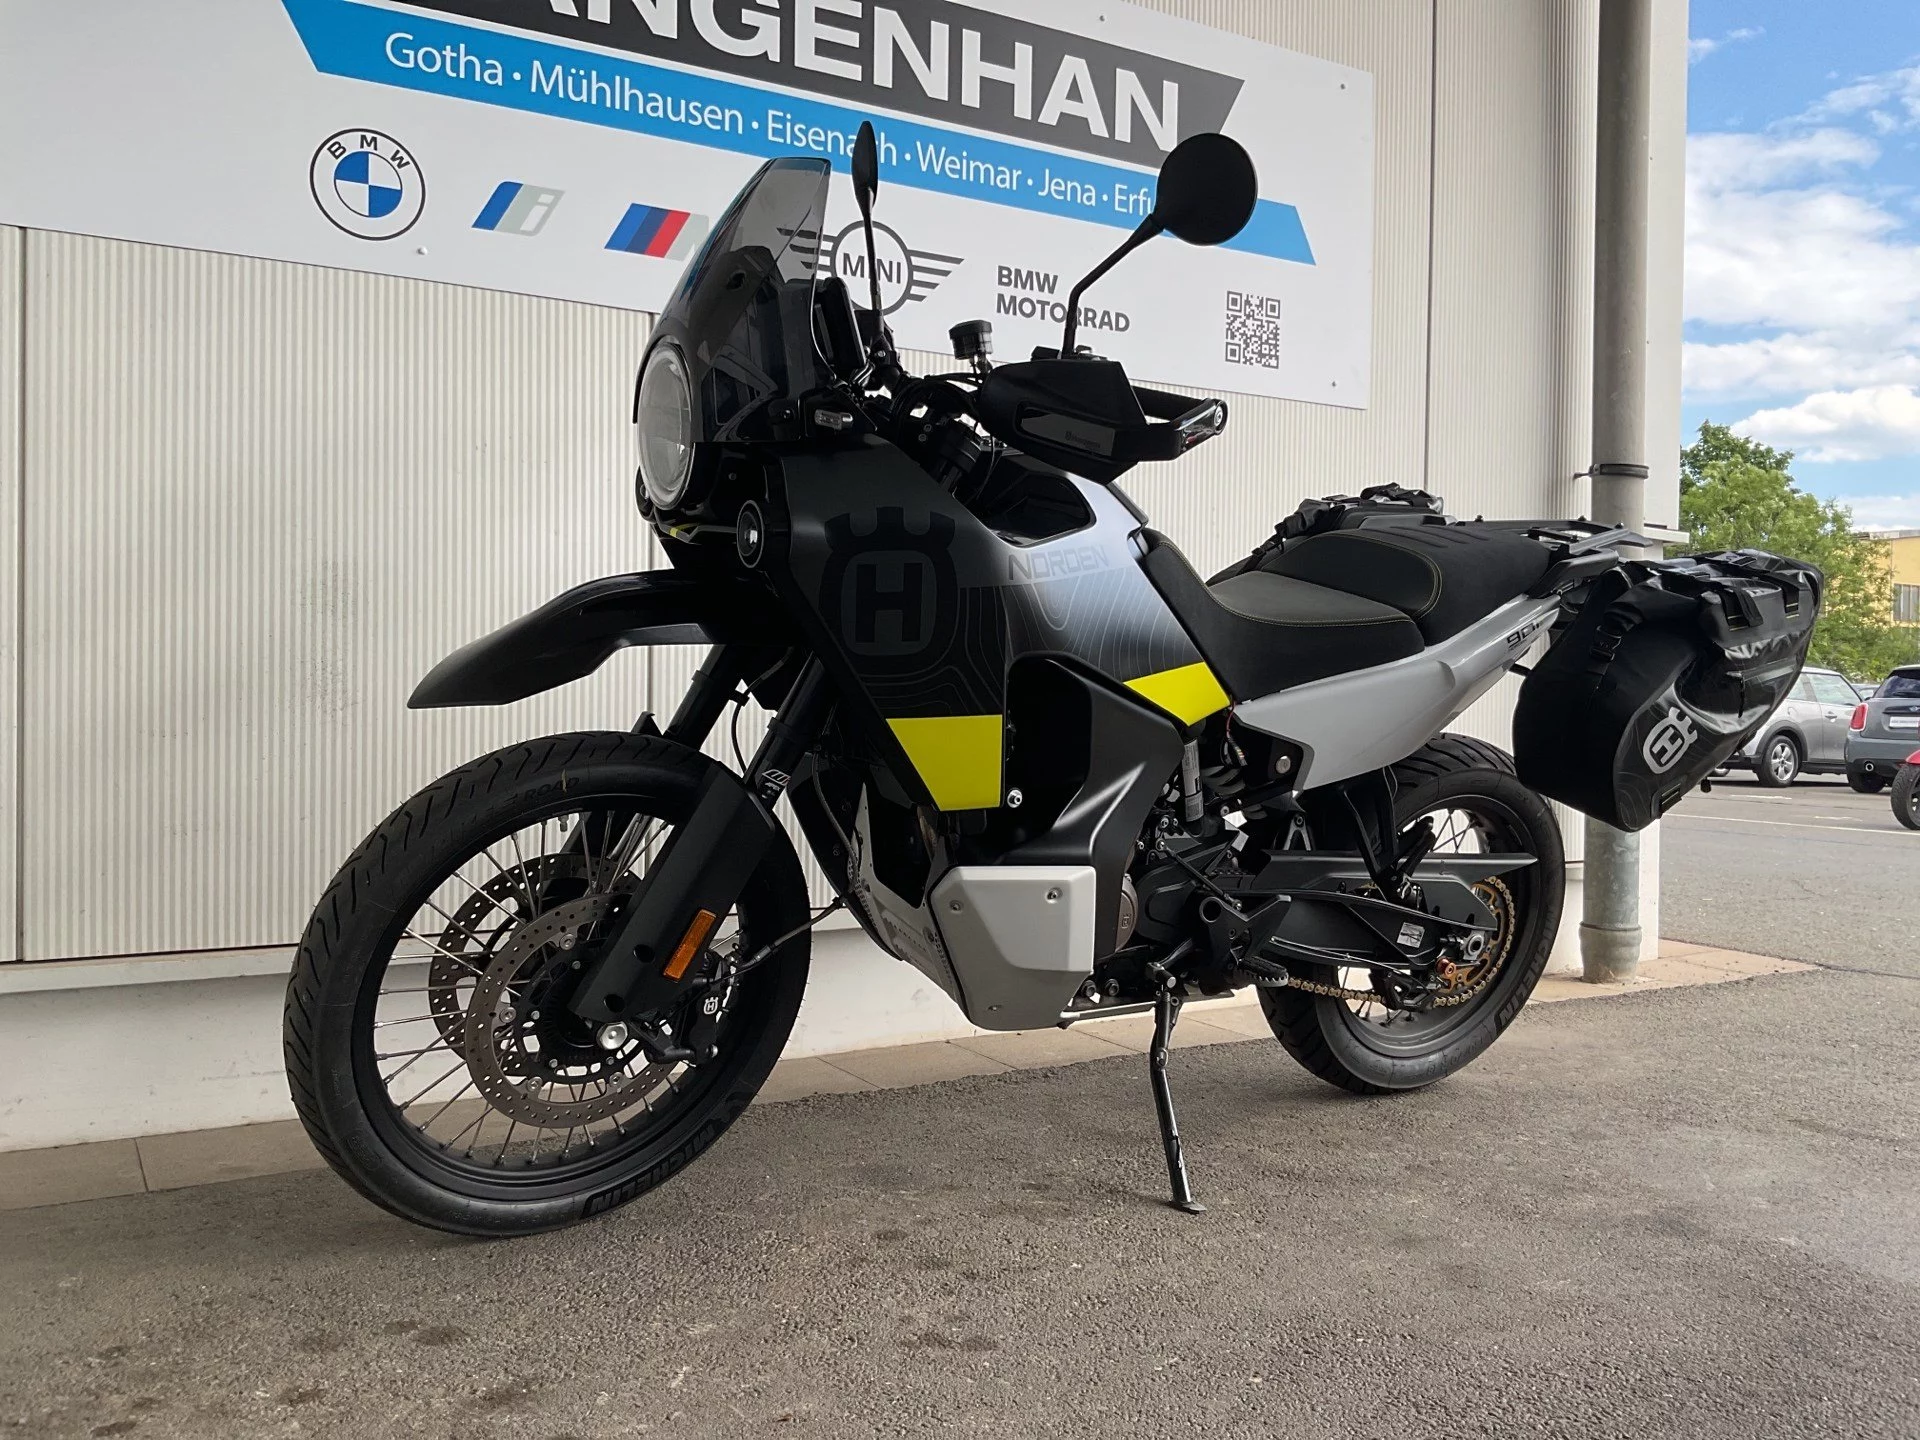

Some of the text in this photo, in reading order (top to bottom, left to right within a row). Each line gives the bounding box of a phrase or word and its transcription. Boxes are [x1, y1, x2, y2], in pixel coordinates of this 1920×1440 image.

[551, 0, 1179, 153] GENHAN
[385, 32, 503, 86] Gotha
[531, 60, 743, 134] Mühlhausen
[767, 109, 896, 166] Eisenh
[916, 140, 1022, 190] Weimar
[1038, 168, 1096, 206] Jena
[326, 134, 411, 170] BMW
[842, 252, 901, 285] MNI
[997, 265, 1058, 294] BMW
[1008, 544, 1111, 581] NORDEN
[589, 1122, 717, 1214] MICHELIN
